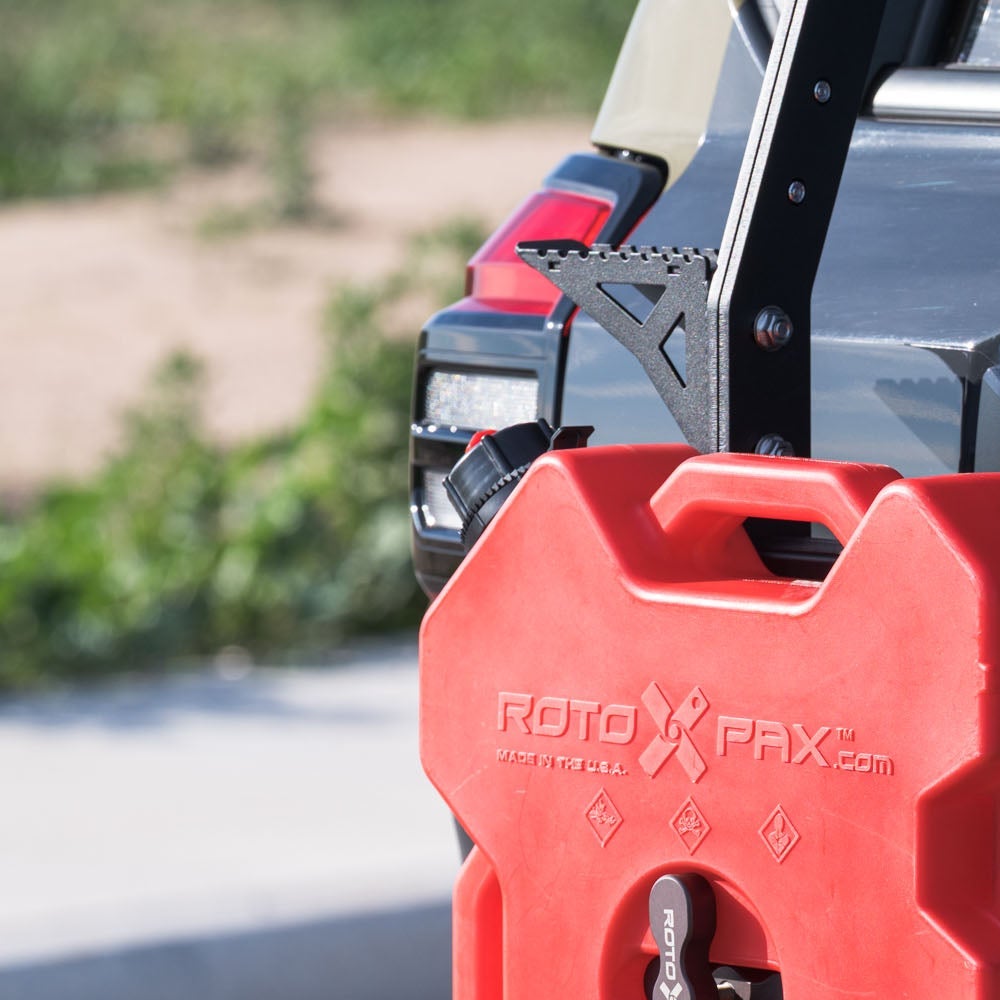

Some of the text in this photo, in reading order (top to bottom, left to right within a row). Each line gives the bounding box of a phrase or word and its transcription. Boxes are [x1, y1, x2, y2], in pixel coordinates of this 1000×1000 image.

[497, 691, 637, 744] ROTO
[497, 749, 628, 776] MADE IN THE U.S.A.
[663, 909, 676, 981] ROTO
